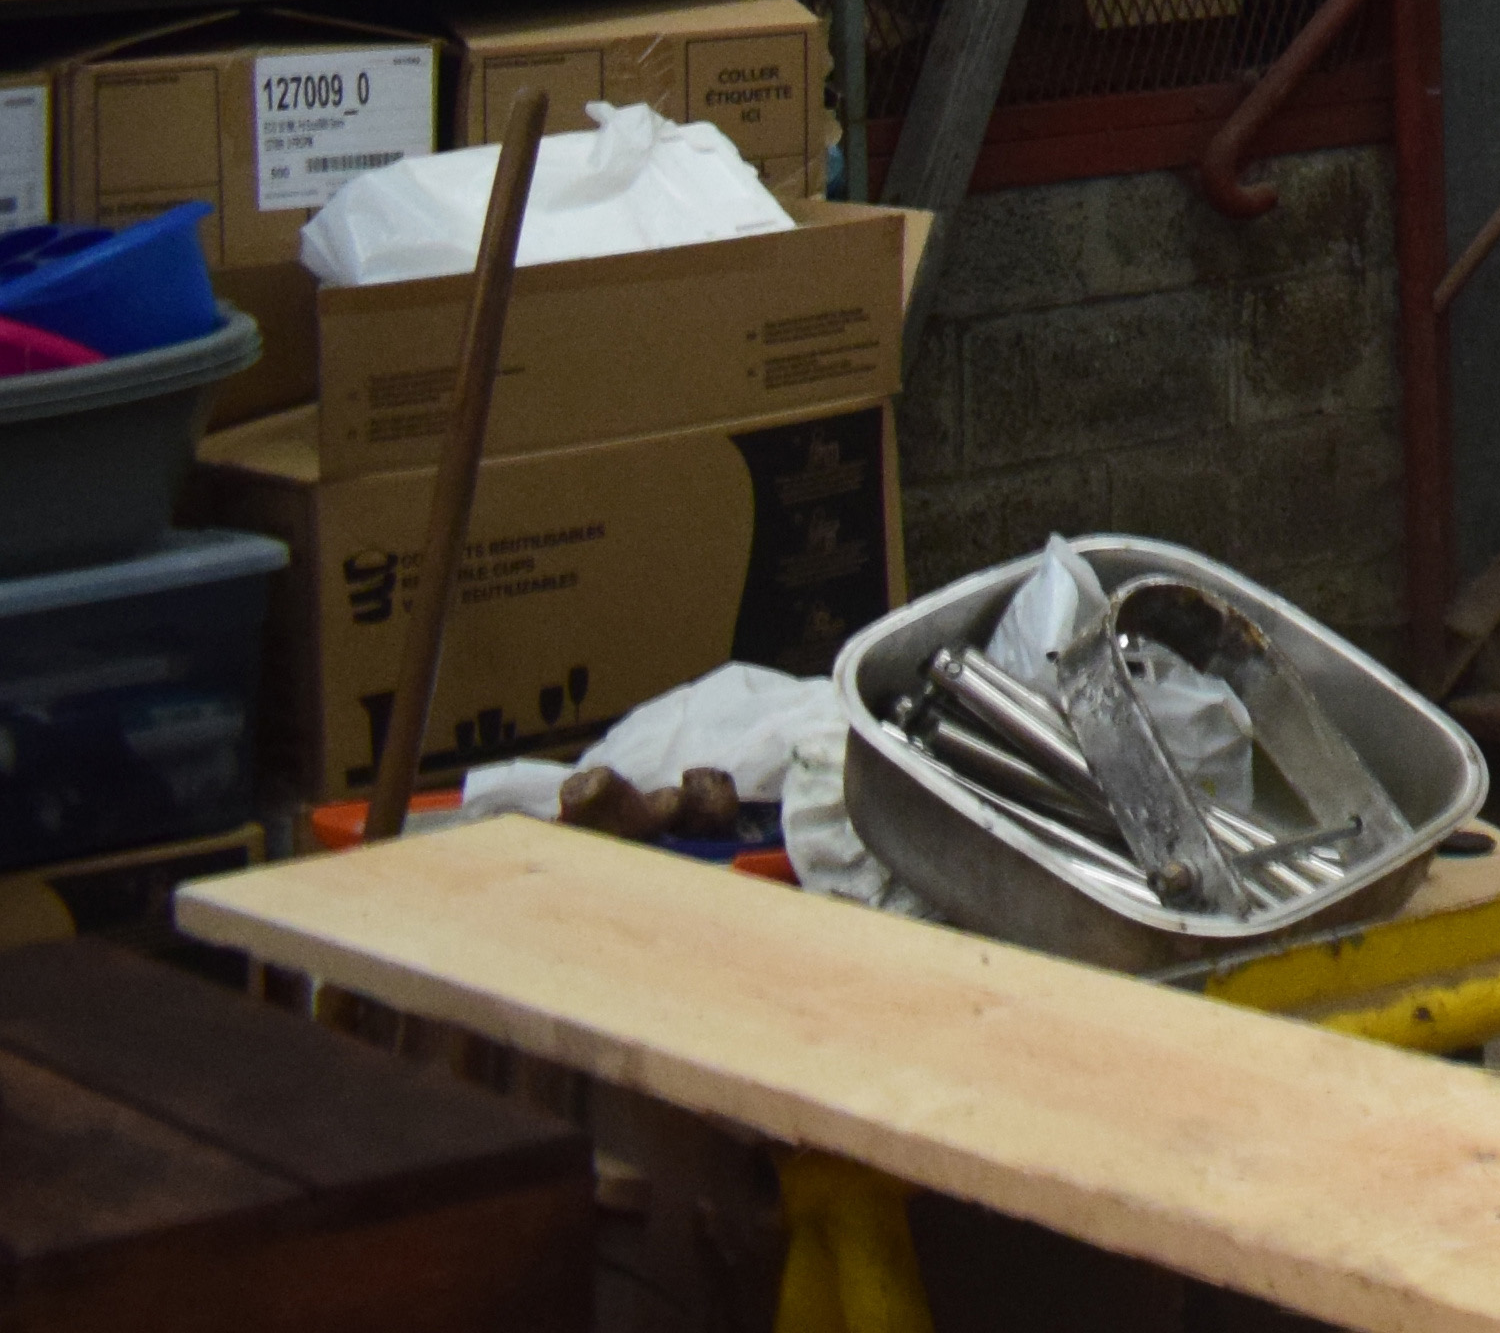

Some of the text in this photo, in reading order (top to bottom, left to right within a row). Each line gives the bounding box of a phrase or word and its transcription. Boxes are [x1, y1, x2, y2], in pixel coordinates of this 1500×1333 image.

[719, 65, 780, 84] COLLER
[263, 72, 370, 116] 127009_0
[705, 86, 793, 106] ÉTIQUETTE
[740, 108, 760, 123] ICI
